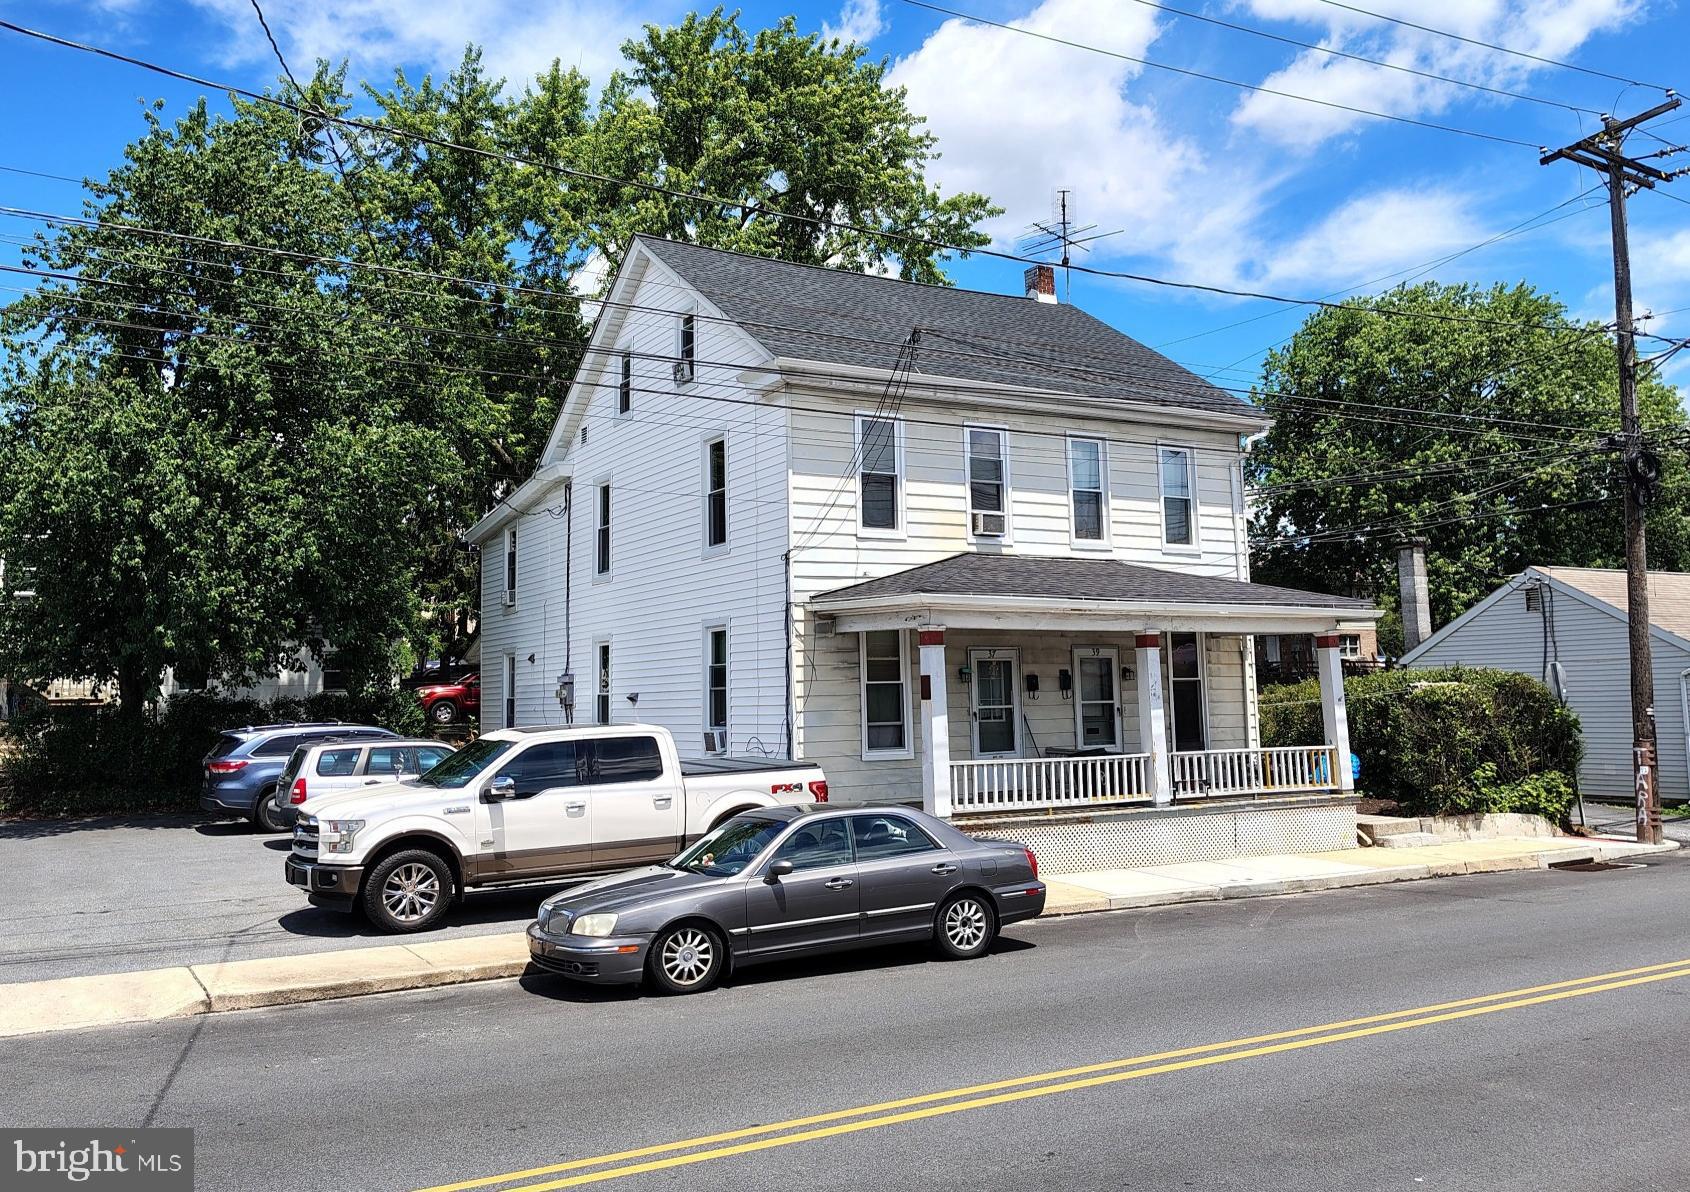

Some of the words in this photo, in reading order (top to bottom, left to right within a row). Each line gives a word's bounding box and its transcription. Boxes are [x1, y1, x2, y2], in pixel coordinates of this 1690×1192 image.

[988, 649, 997, 659] 37
[1091, 647, 1100, 657] 39
[771, 782, 803, 794] FX4
